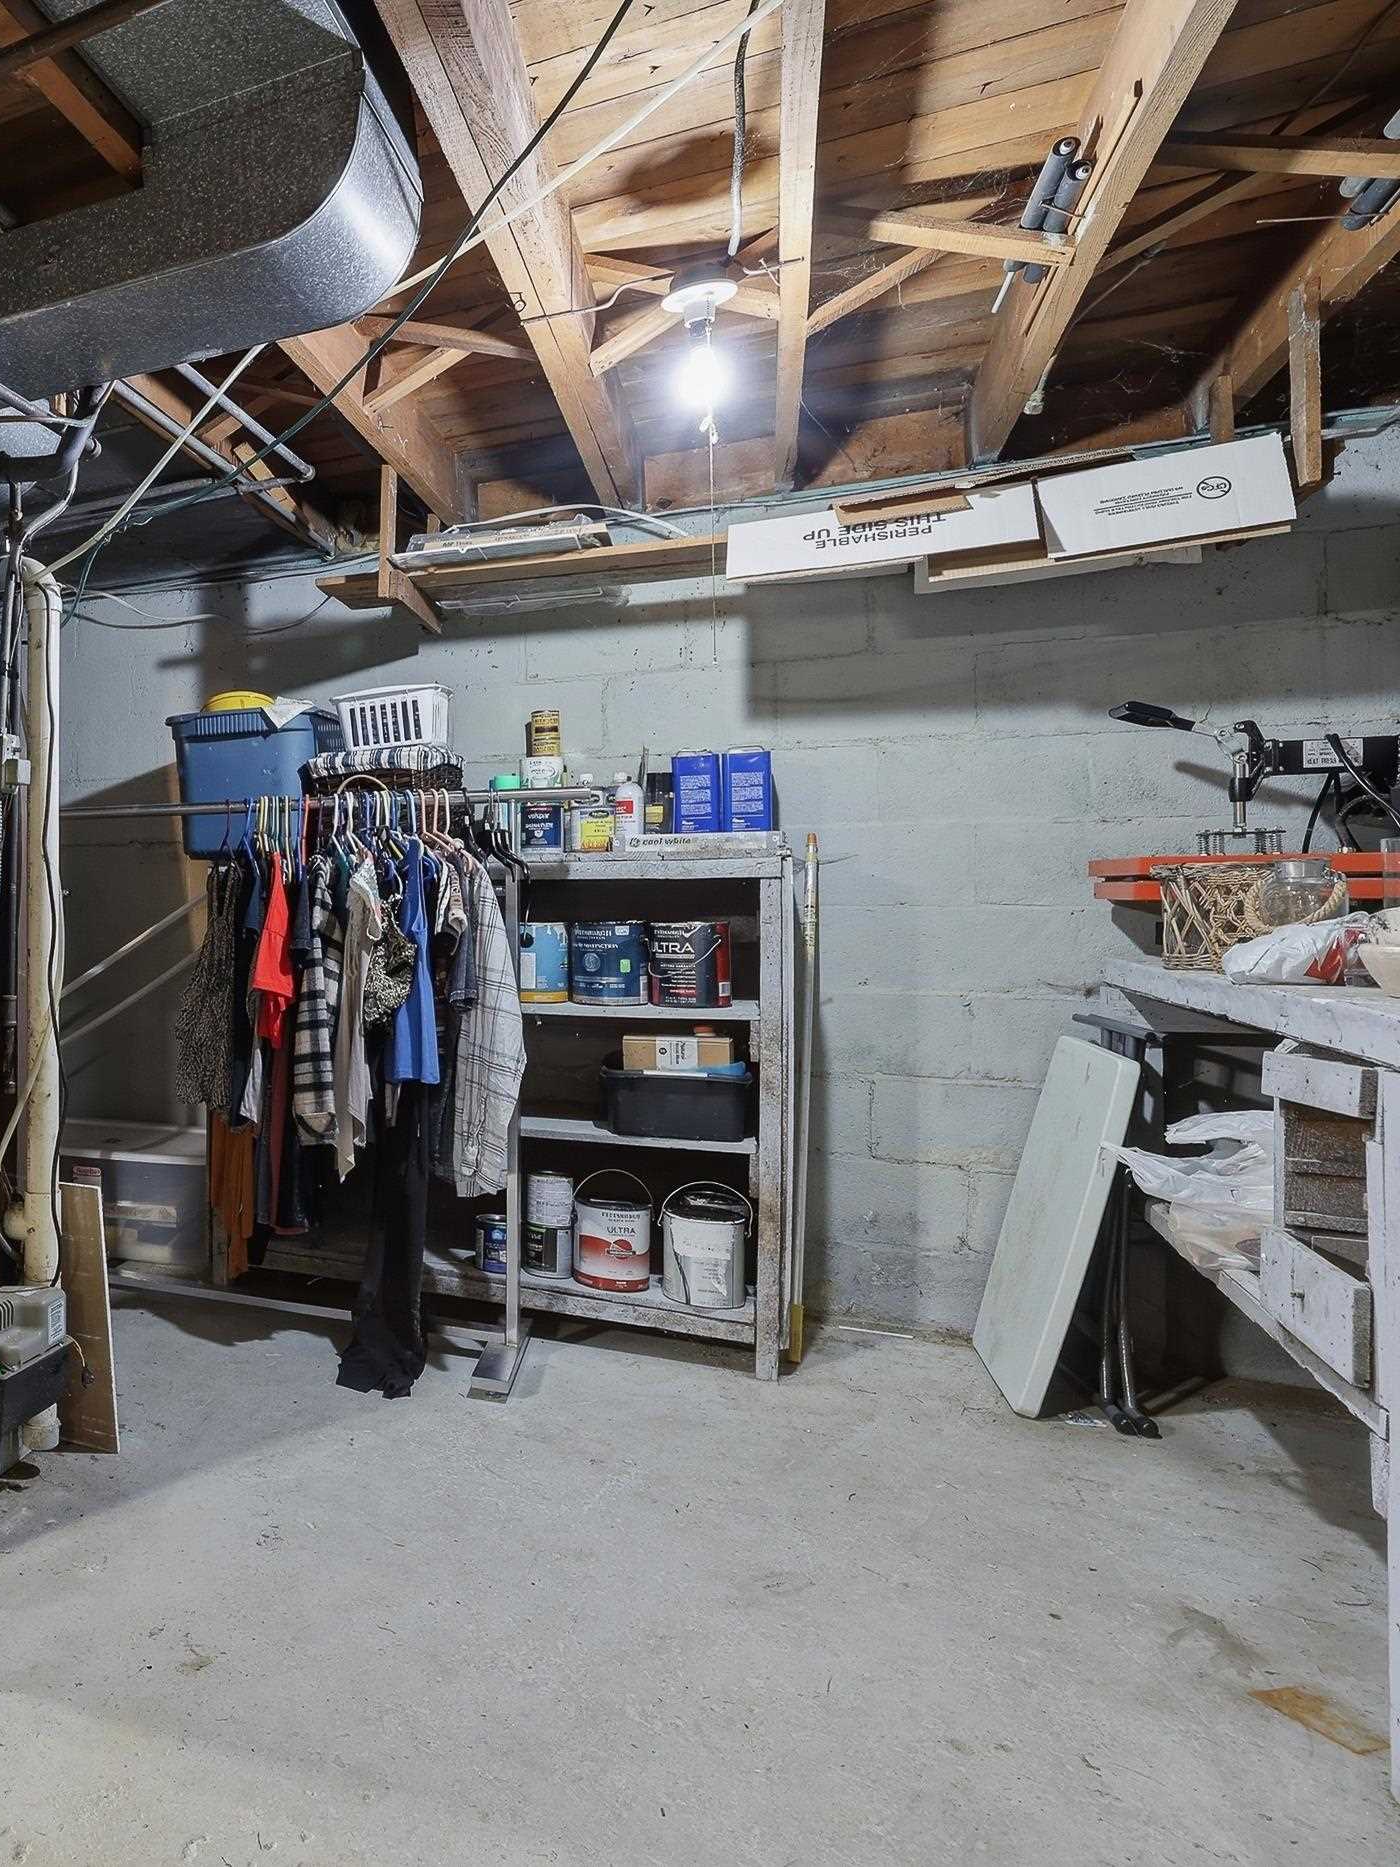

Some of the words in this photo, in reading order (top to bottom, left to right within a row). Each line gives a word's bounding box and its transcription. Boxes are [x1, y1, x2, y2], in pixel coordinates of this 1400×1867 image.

[803, 528, 831, 541] UP
[839, 520, 888, 536] SIDE
[815, 525, 932, 549] PERISHABLE
[642, 837, 663, 846] cool
[664, 837, 692, 845] white
[606, 1226, 637, 1234] ULTRA
